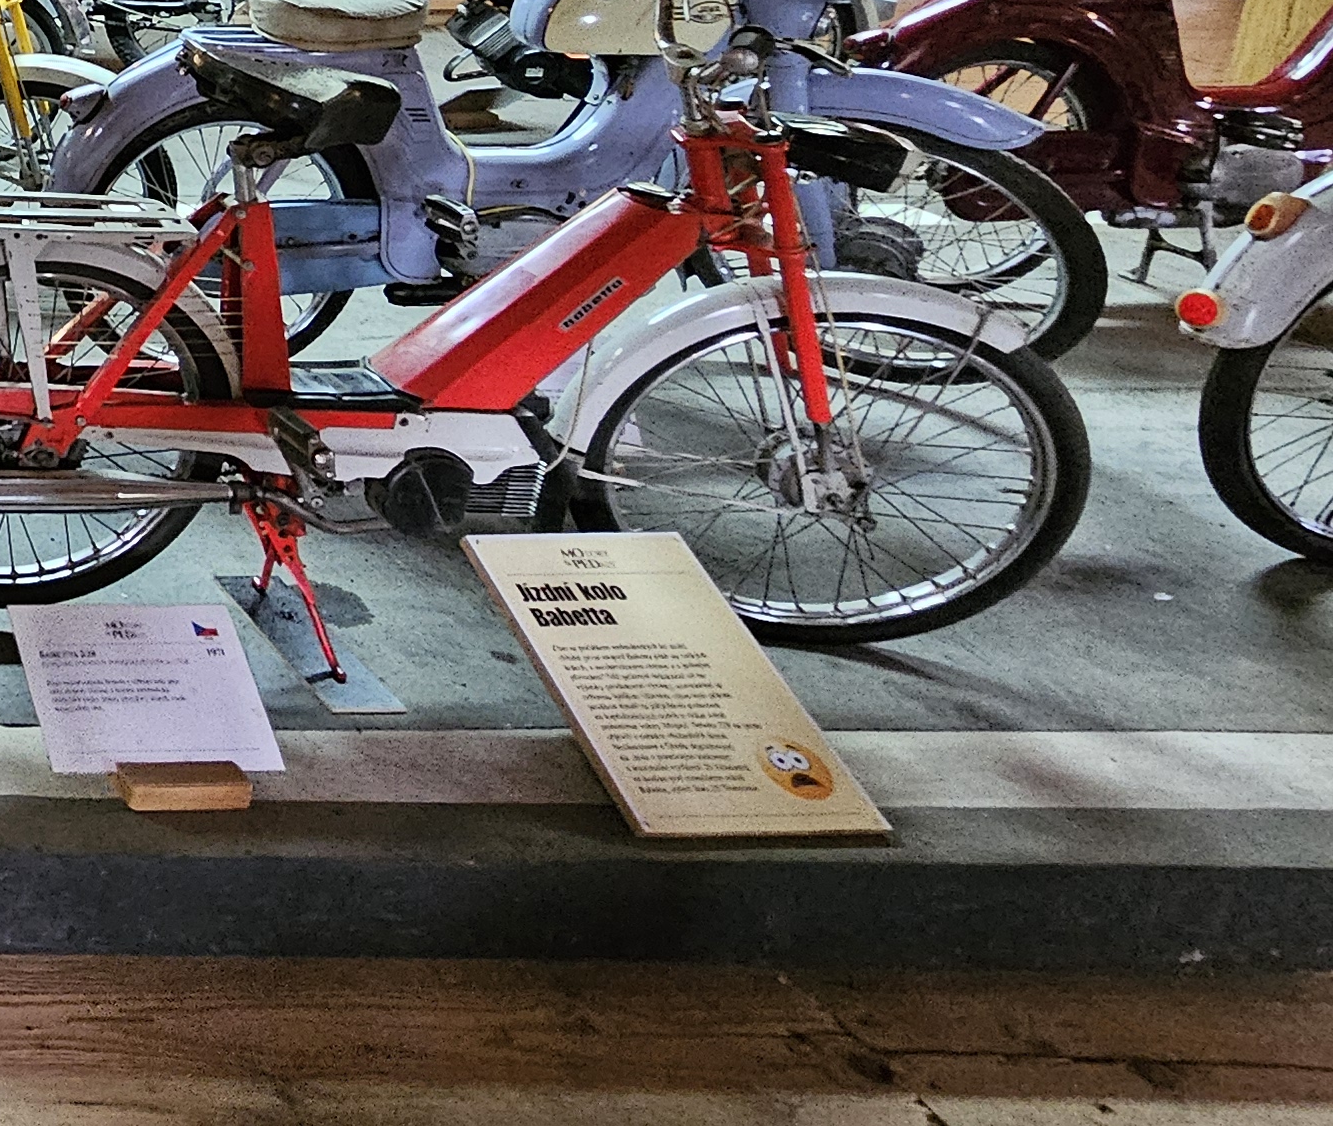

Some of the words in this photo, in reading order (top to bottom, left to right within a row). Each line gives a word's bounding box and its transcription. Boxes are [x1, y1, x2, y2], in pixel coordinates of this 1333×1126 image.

[516, 581, 578, 602] Jízdní
[575, 582, 628, 601] kolo
[531, 606, 619, 627] Babetta
